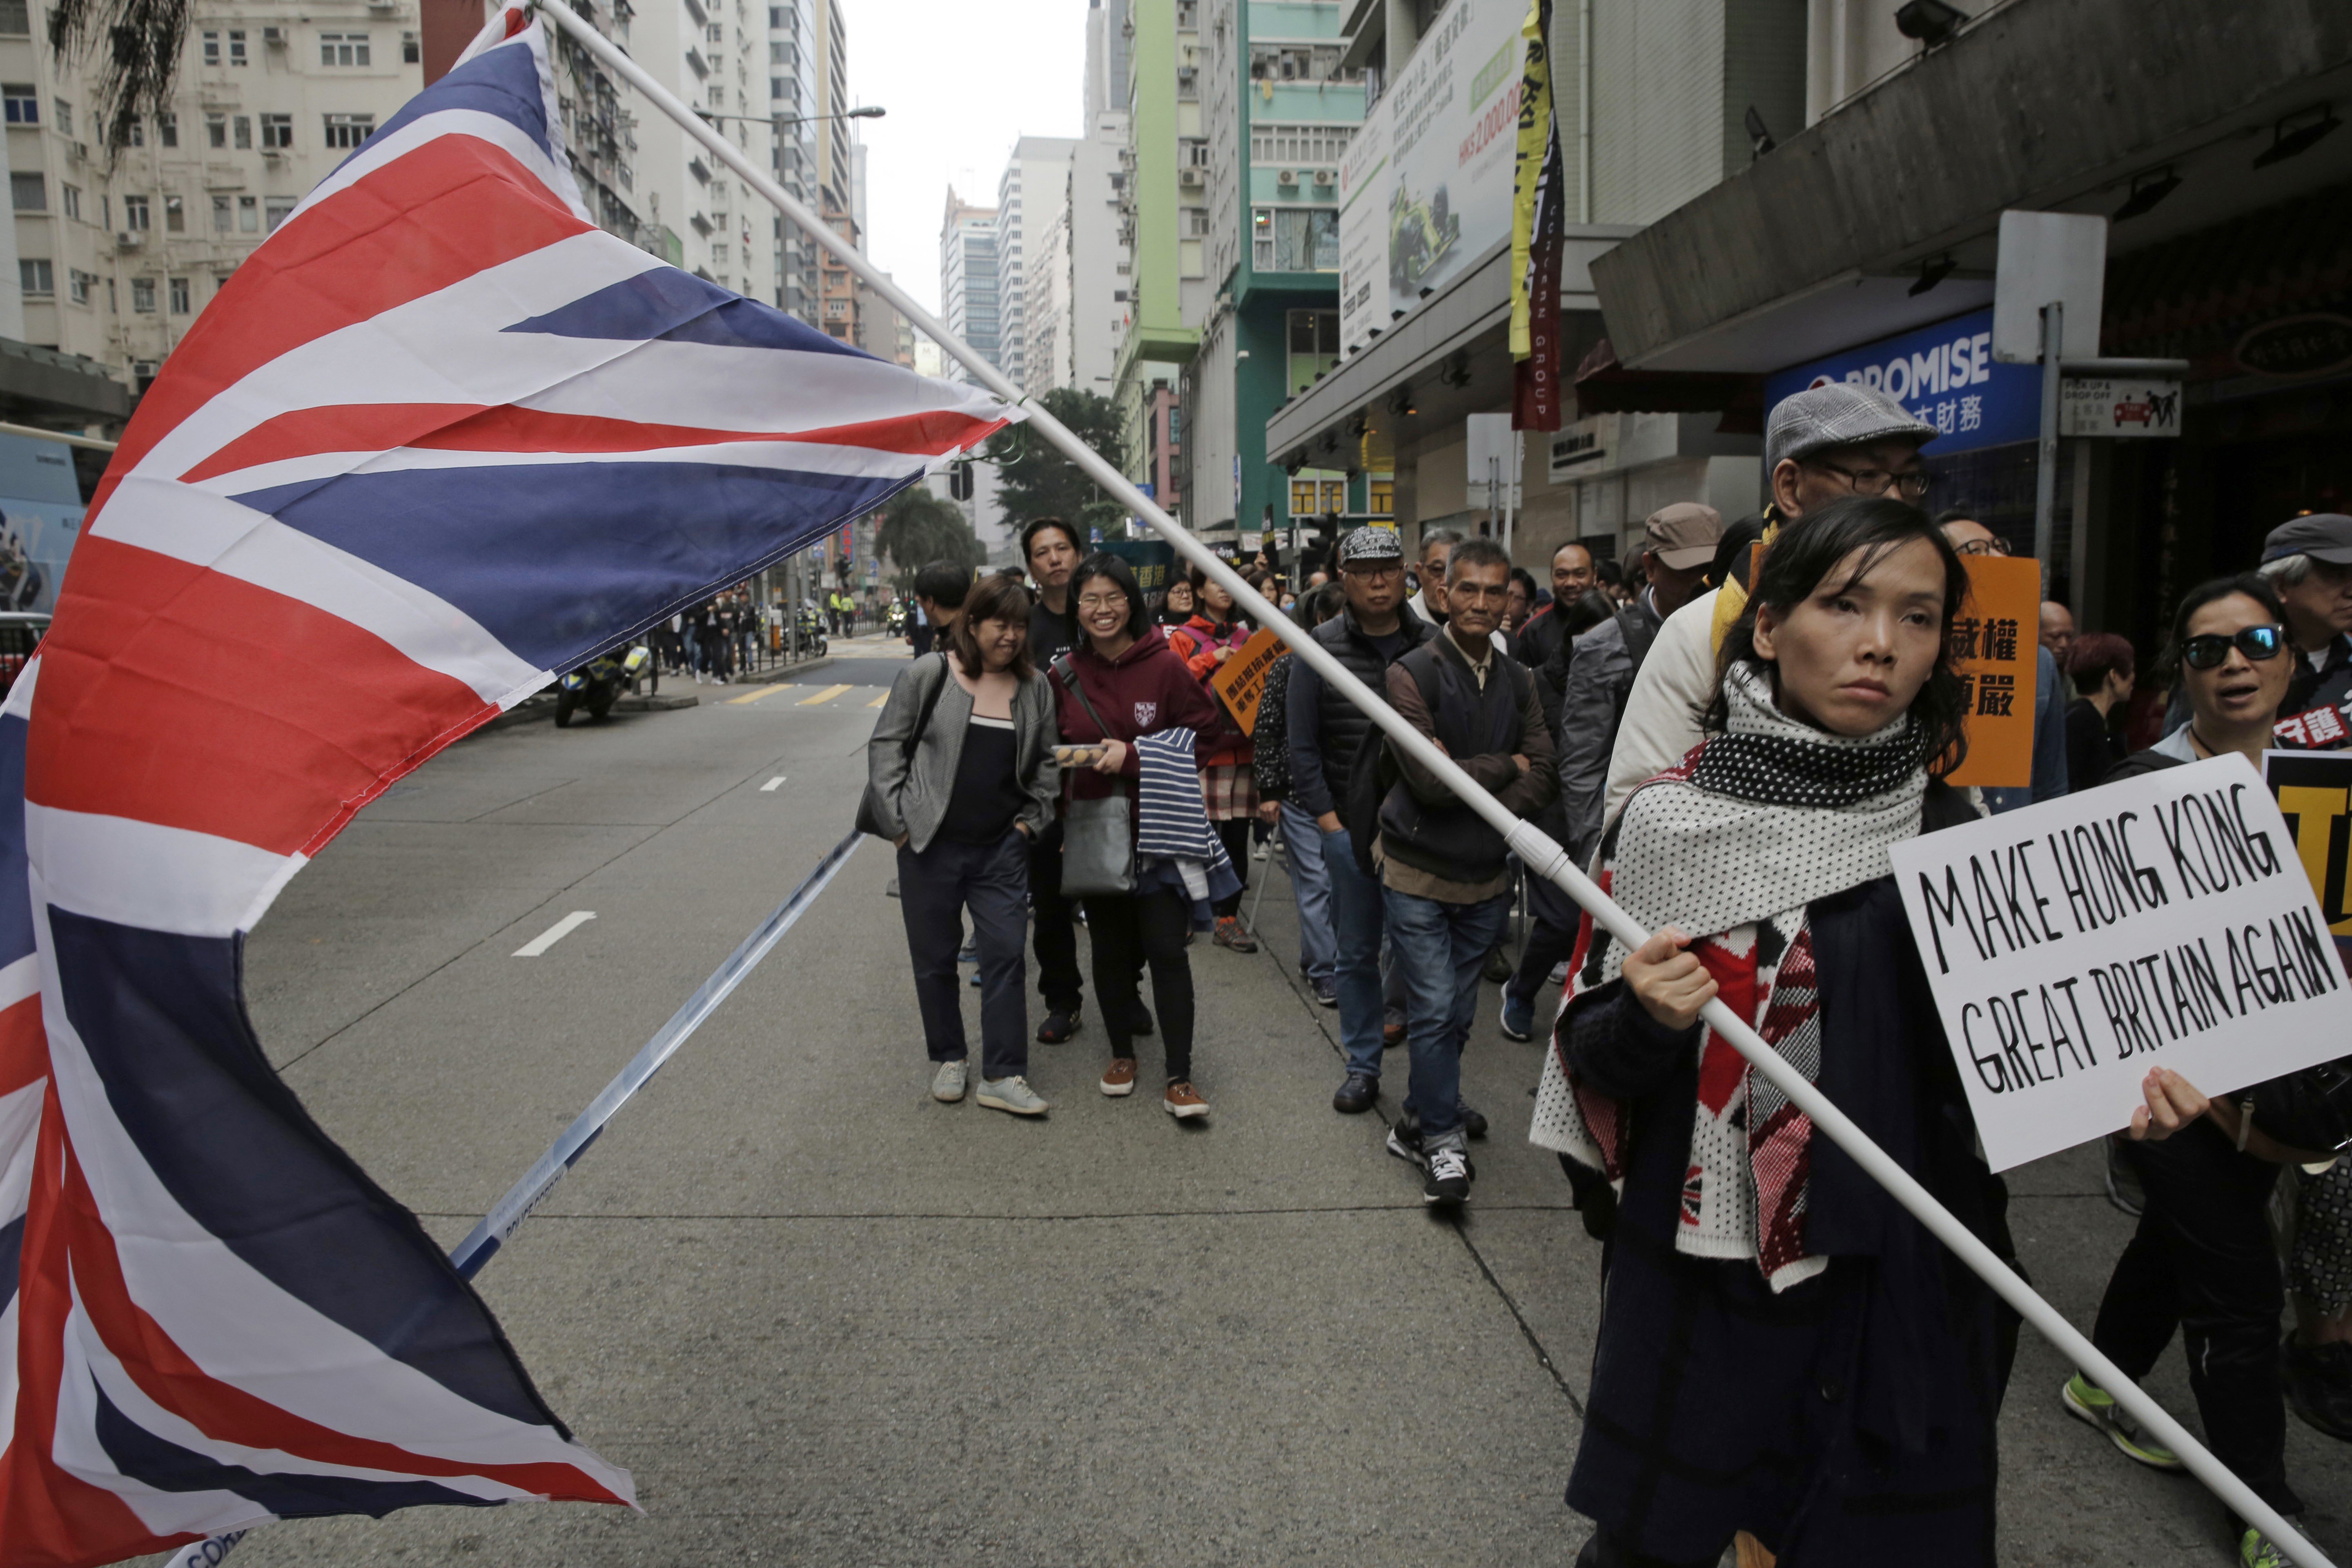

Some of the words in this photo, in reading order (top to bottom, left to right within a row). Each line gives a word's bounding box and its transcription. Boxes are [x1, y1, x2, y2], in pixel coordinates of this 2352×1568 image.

[1536, 336, 1546, 414] GROUP
[2065, 391, 2091, 399] DROP
[2093, 391, 2111, 399] OFF
[1919, 840, 2062, 974] MAKE
[2048, 811, 2169, 933] HONG
[2154, 783, 2282, 898] KONG
[2278, 785, 2352, 922] T
[1962, 977, 2097, 1094] GREAT
[2089, 938, 2234, 1060] BRITAIN
[2225, 906, 2338, 1016] AGAIN
